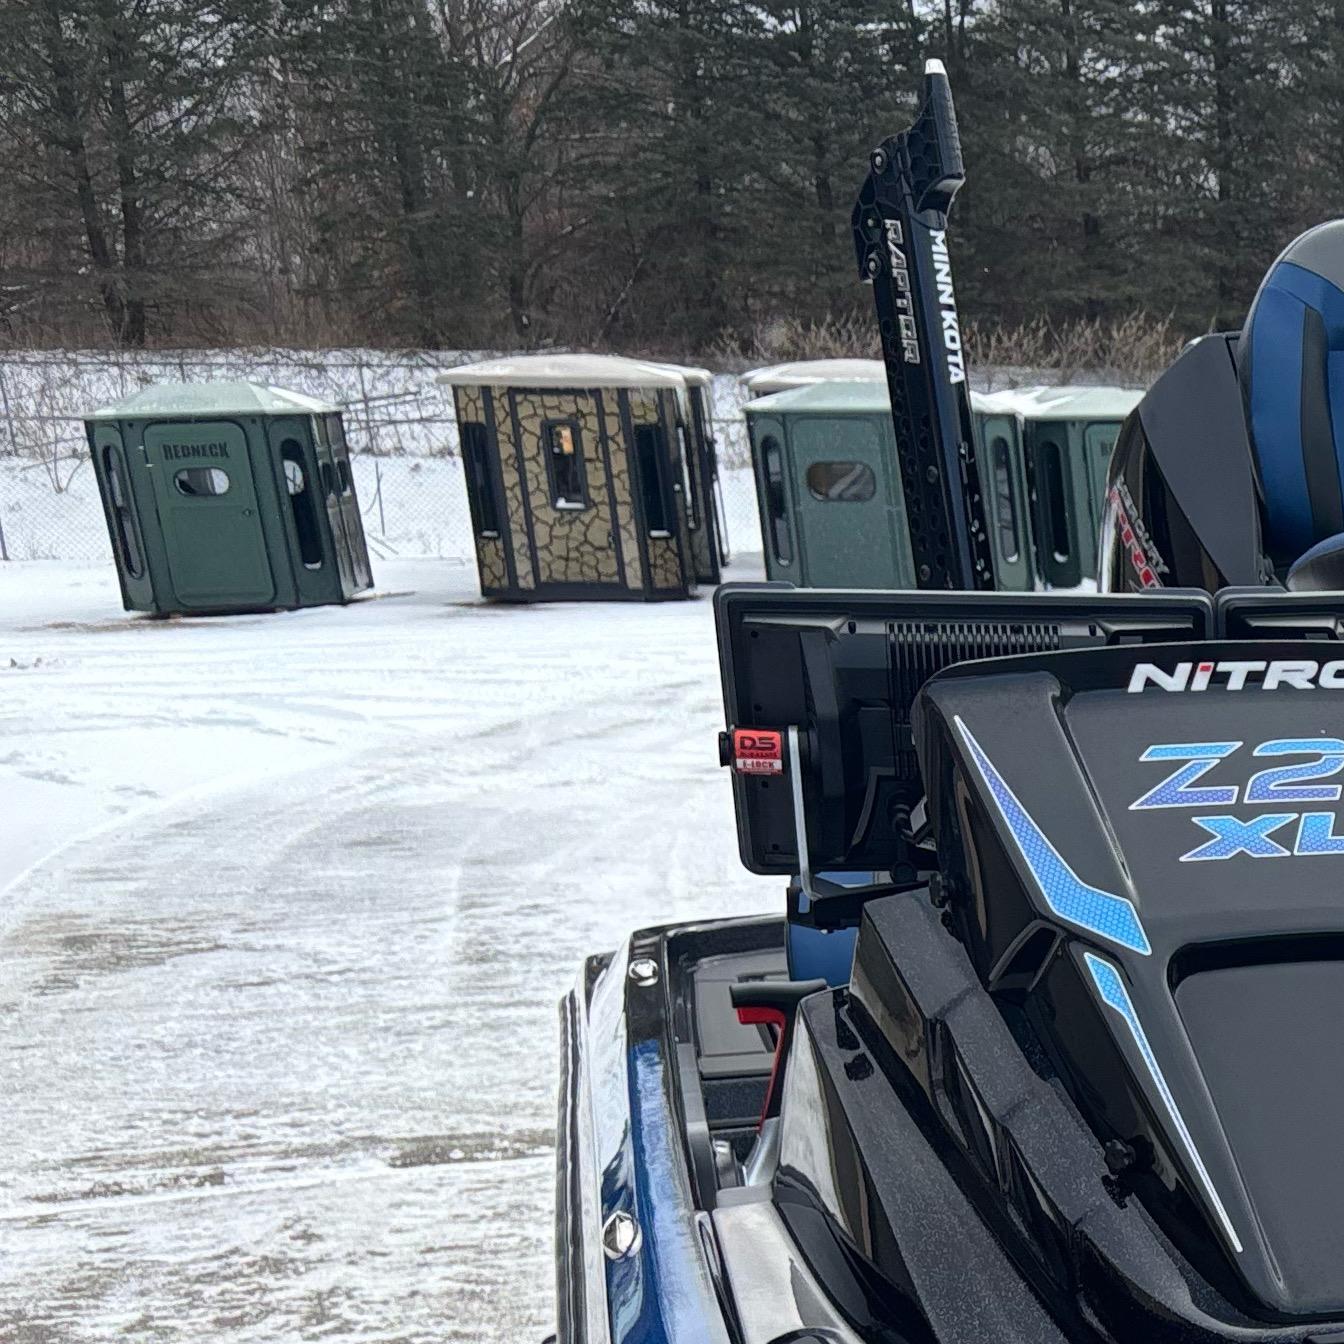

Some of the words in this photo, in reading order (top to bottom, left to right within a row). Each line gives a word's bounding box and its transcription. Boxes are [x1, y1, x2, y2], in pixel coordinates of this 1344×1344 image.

[930, 229, 955, 305] MINN
[941, 310, 965, 384] KOTA
[162, 441, 230, 461] REDNECK
